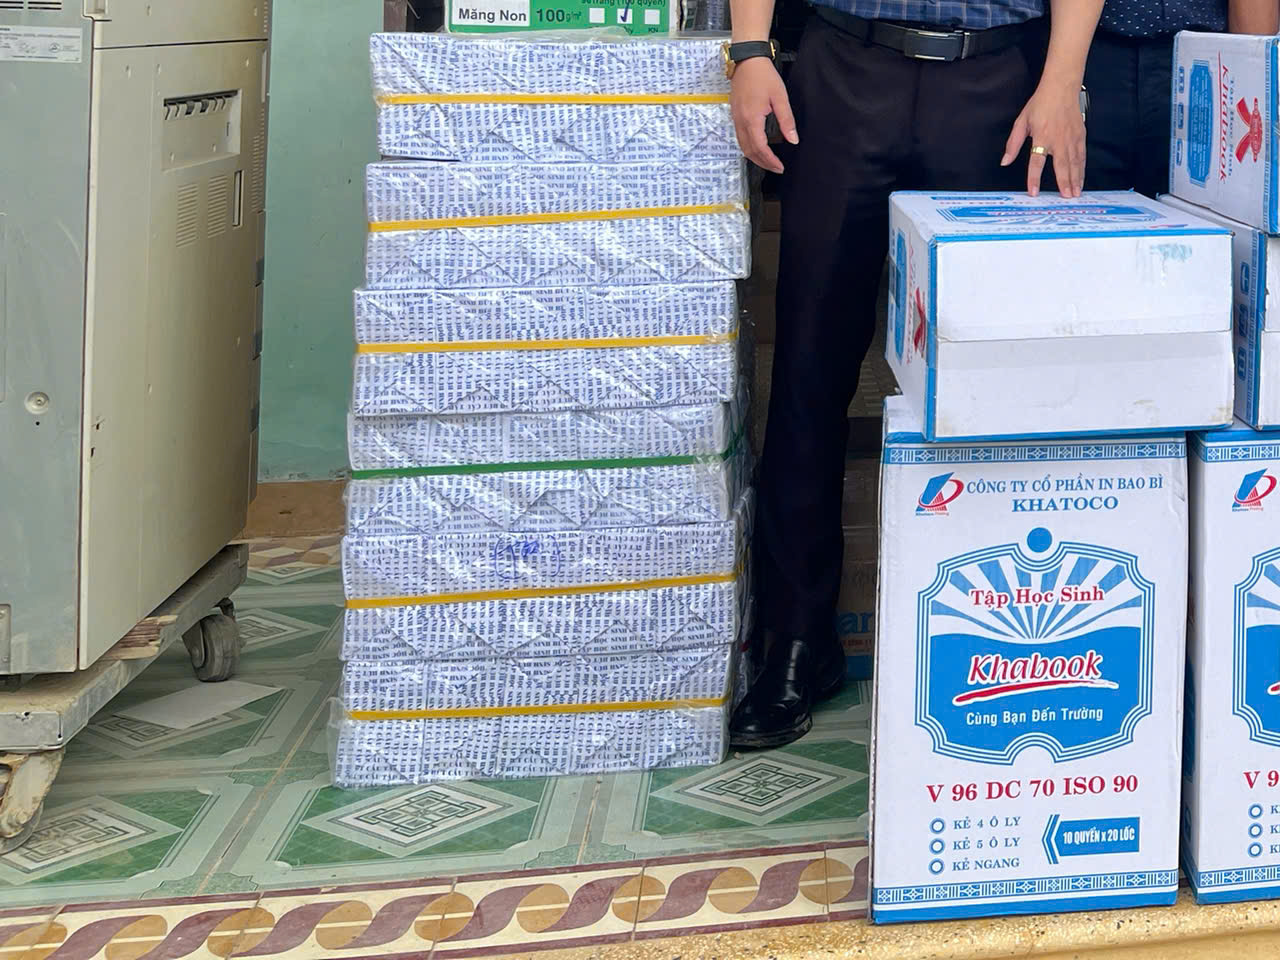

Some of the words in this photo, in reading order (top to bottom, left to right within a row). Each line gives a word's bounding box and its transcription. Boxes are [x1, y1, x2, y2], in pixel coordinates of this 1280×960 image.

[458, 7, 495, 24] Măng
[500, 9, 527, 22] Non
[536, 8, 565, 22] 100
[967, 479, 1006, 494] CÔNG
[1011, 481, 1028, 493] TY
[1033, 473, 1050, 492] CỔ
[1056, 472, 1090, 491] PHẦN
[1099, 479, 1113, 490] IN
[1117, 477, 1145, 489] BAO
[1150, 473, 1163, 488] BÌ
[1012, 496, 1118, 512] KHATOCO
[971, 590, 1008, 609] Tập
[1016, 589, 1054, 607] Học
[1061, 586, 1104, 603] Sinh
[969, 650, 1102, 681] Khabook
[966, 712, 997, 725] Cùng
[1003, 711, 1026, 724] Bạn
[1032, 707, 1055, 722] Đến
[1061, 707, 1103, 721] Trường
[927, 785, 944, 803] V
[952, 783, 977, 801] 96
[986, 781, 1020, 799] DC
[1031, 779, 1054, 797] 70
[1063, 776, 1105, 796] ISO
[1114, 775, 1138, 793] 90
[1244, 771, 1260, 789] V
[954, 816, 970, 830] KẺ
[977, 818, 983, 828] 4
[989, 815, 998, 827] Ô
[1005, 816, 1020, 827] LY
[953, 836, 970, 850] KẺ
[976, 839, 983, 849] 5
[989, 836, 998, 848] Ô
[1005, 837, 1020, 847] LY
[1063, 832, 1073, 844] 10
[1074, 826, 1099, 843] QUYỂN
[1107, 831, 1117, 840] 20
[1117, 828, 1135, 840] LỐC
[952, 857, 969, 871] KẺ
[974, 857, 1020, 870] NGANG
